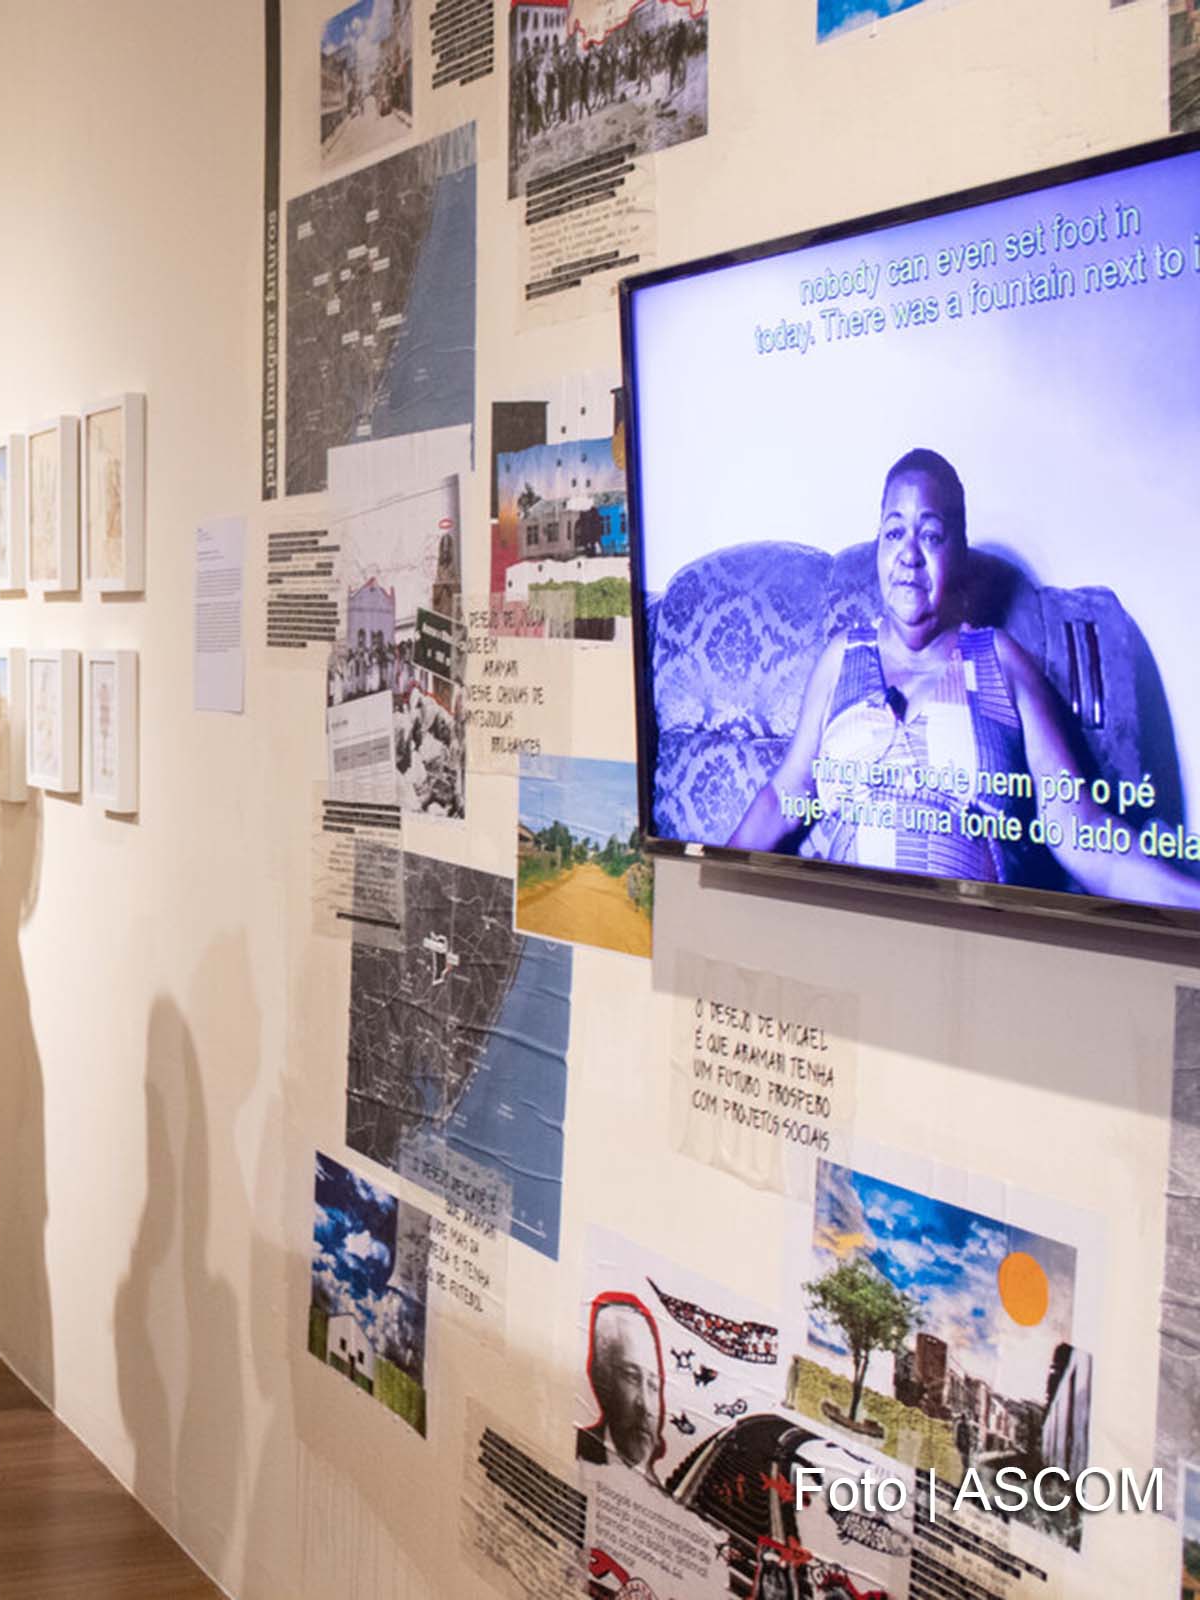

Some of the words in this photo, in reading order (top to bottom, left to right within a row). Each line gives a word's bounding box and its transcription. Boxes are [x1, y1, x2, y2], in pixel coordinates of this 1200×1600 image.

[799, 259, 881, 306] nobody
[886, 254, 929, 286] can
[936, 238, 997, 276] even
[1004, 220, 1046, 262] set
[1052, 207, 1108, 252] foot
[1115, 200, 1141, 239] in
[754, 318, 816, 355] today.
[819, 306, 886, 343] There
[891, 296, 939, 329] was
[945, 291, 962, 319] a
[968, 262, 1075, 315] fountain
[1083, 247, 1148, 294] next
[1154, 240, 1185, 280] to
[913, 760, 970, 794] pode
[977, 770, 1033, 798] nem
[1041, 768, 1086, 808] pôr
[1091, 778, 1111, 804] o
[1118, 773, 1156, 815] pé
[837, 795, 896, 830] Tinha
[902, 807, 952, 834] uma
[960, 804, 1022, 842] fonte
[1029, 812, 1063, 846] do
[1071, 814, 1131, 854] lado
[1139, 821, 1200, 861] dela
[695, 997, 703, 1018] O
[710, 1000, 751, 1033] DESEJO
[758, 1013, 774, 1038] DE
[777, 1019, 828, 1051] MICAEL
[693, 1058, 713, 1081] UM
[717, 1065, 761, 1098] FUTURO
[706, 1033, 729, 1056] QUE
[789, 1055, 834, 1088] TENHA
[692, 1089, 718, 1115] COM
[722, 1098, 780, 1136] PROJETOS
[782, 1117, 830, 1153] SOCIAIS
